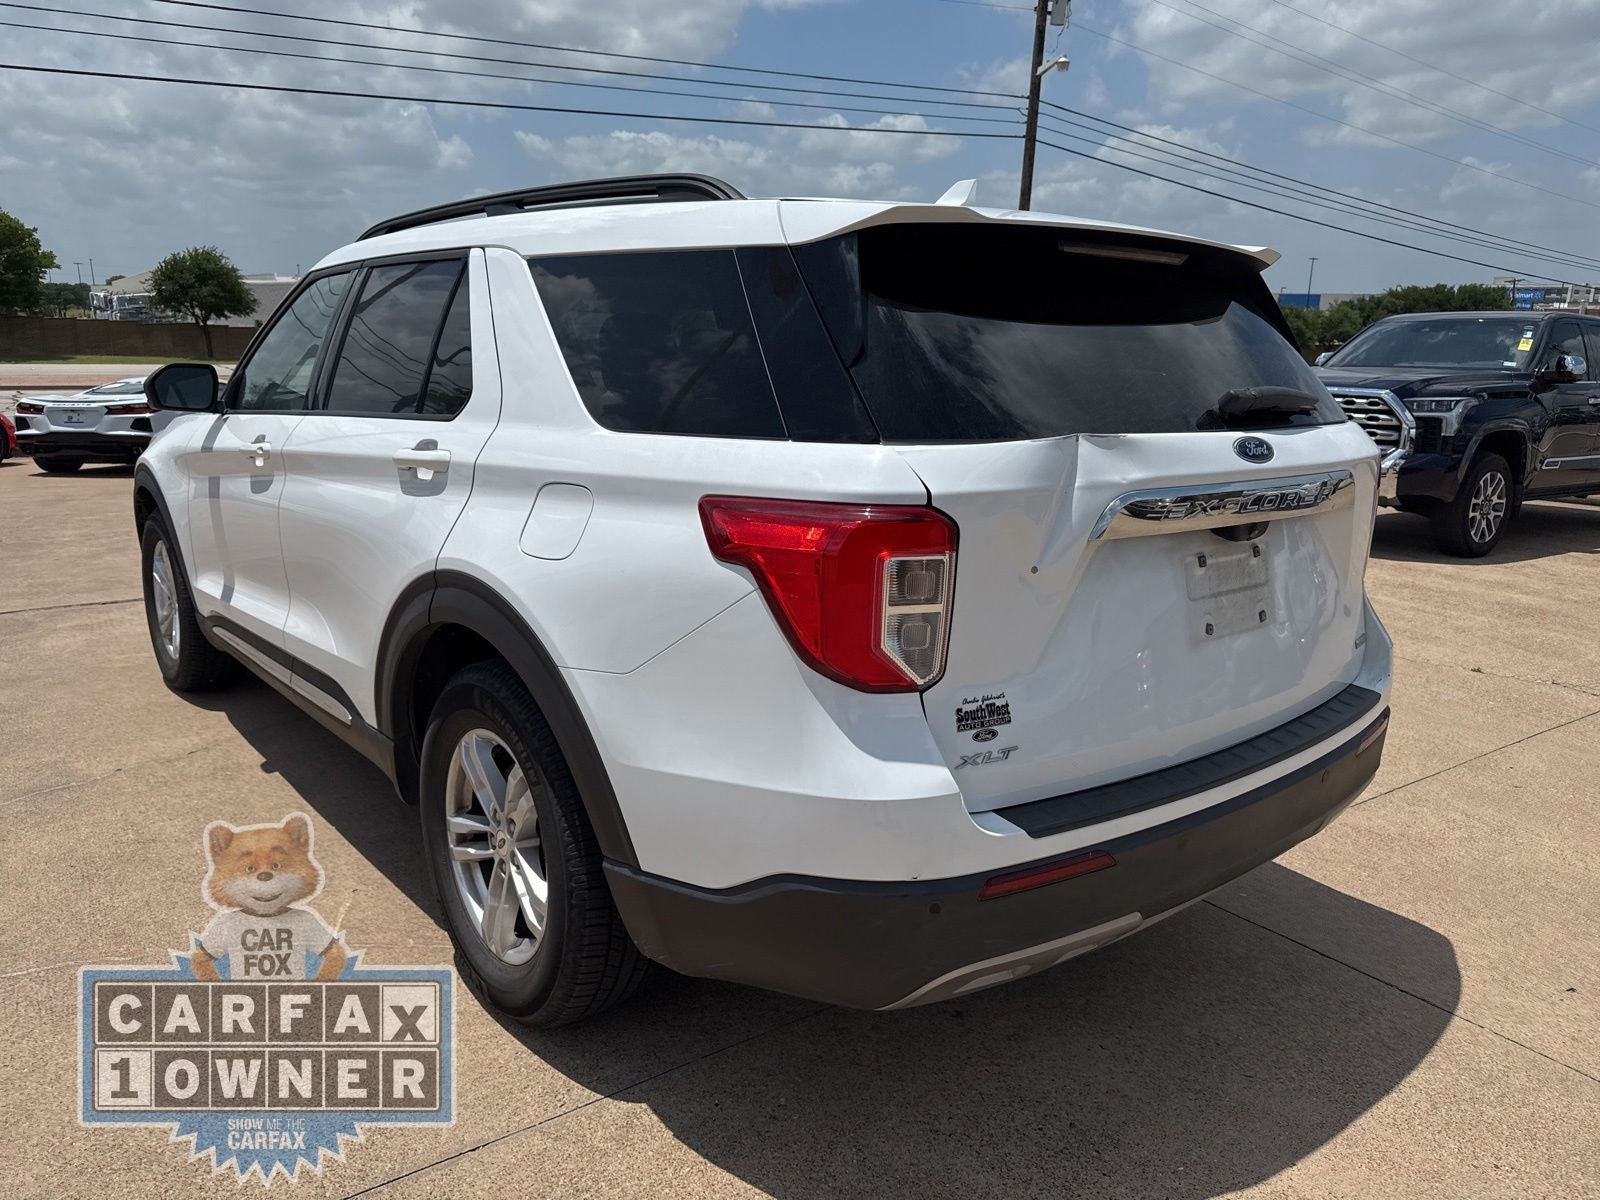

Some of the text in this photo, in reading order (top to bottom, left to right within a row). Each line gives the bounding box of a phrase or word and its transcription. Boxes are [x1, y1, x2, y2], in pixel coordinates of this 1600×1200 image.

[1161, 481, 1338, 521] EXPLORER
[959, 716, 1011, 731] AUTO GROUP
[954, 745, 1019, 770] XLT
